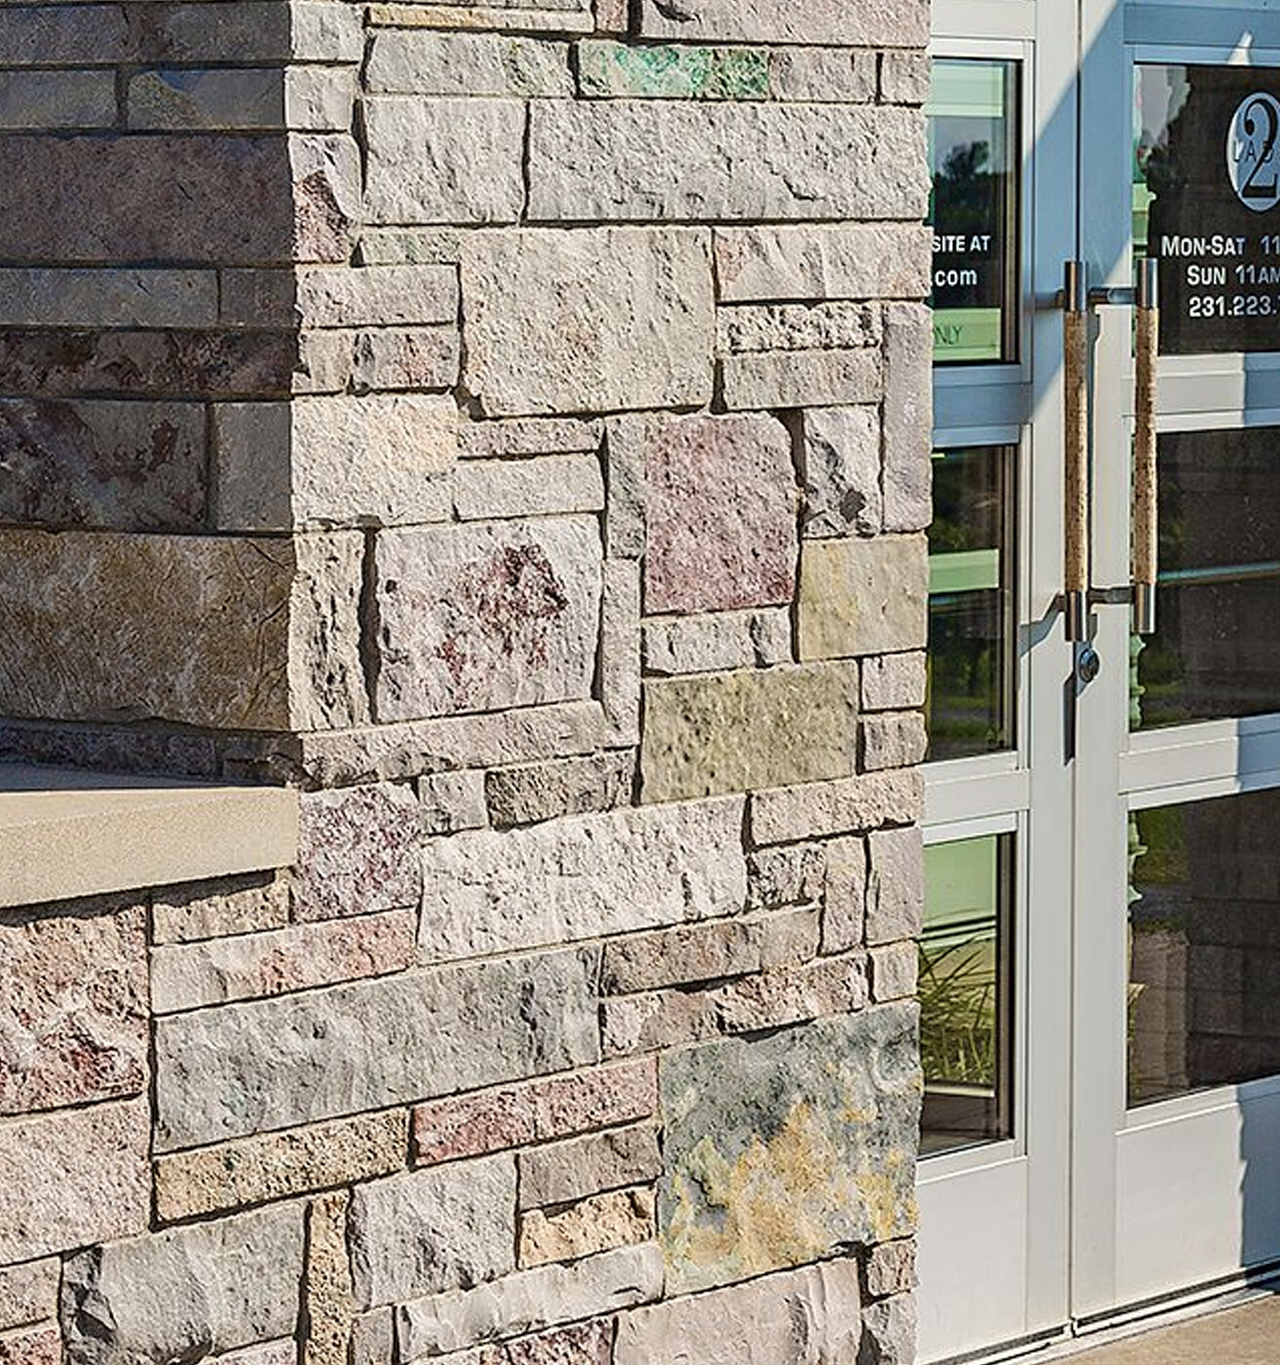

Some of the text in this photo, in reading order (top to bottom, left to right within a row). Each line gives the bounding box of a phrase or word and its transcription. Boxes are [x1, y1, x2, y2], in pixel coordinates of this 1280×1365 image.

[1242, 98, 1278, 198] 2
[969, 235, 992, 251] AT
[1161, 235, 1246, 257] MON-SAT
[1187, 265, 1227, 286] SUN
